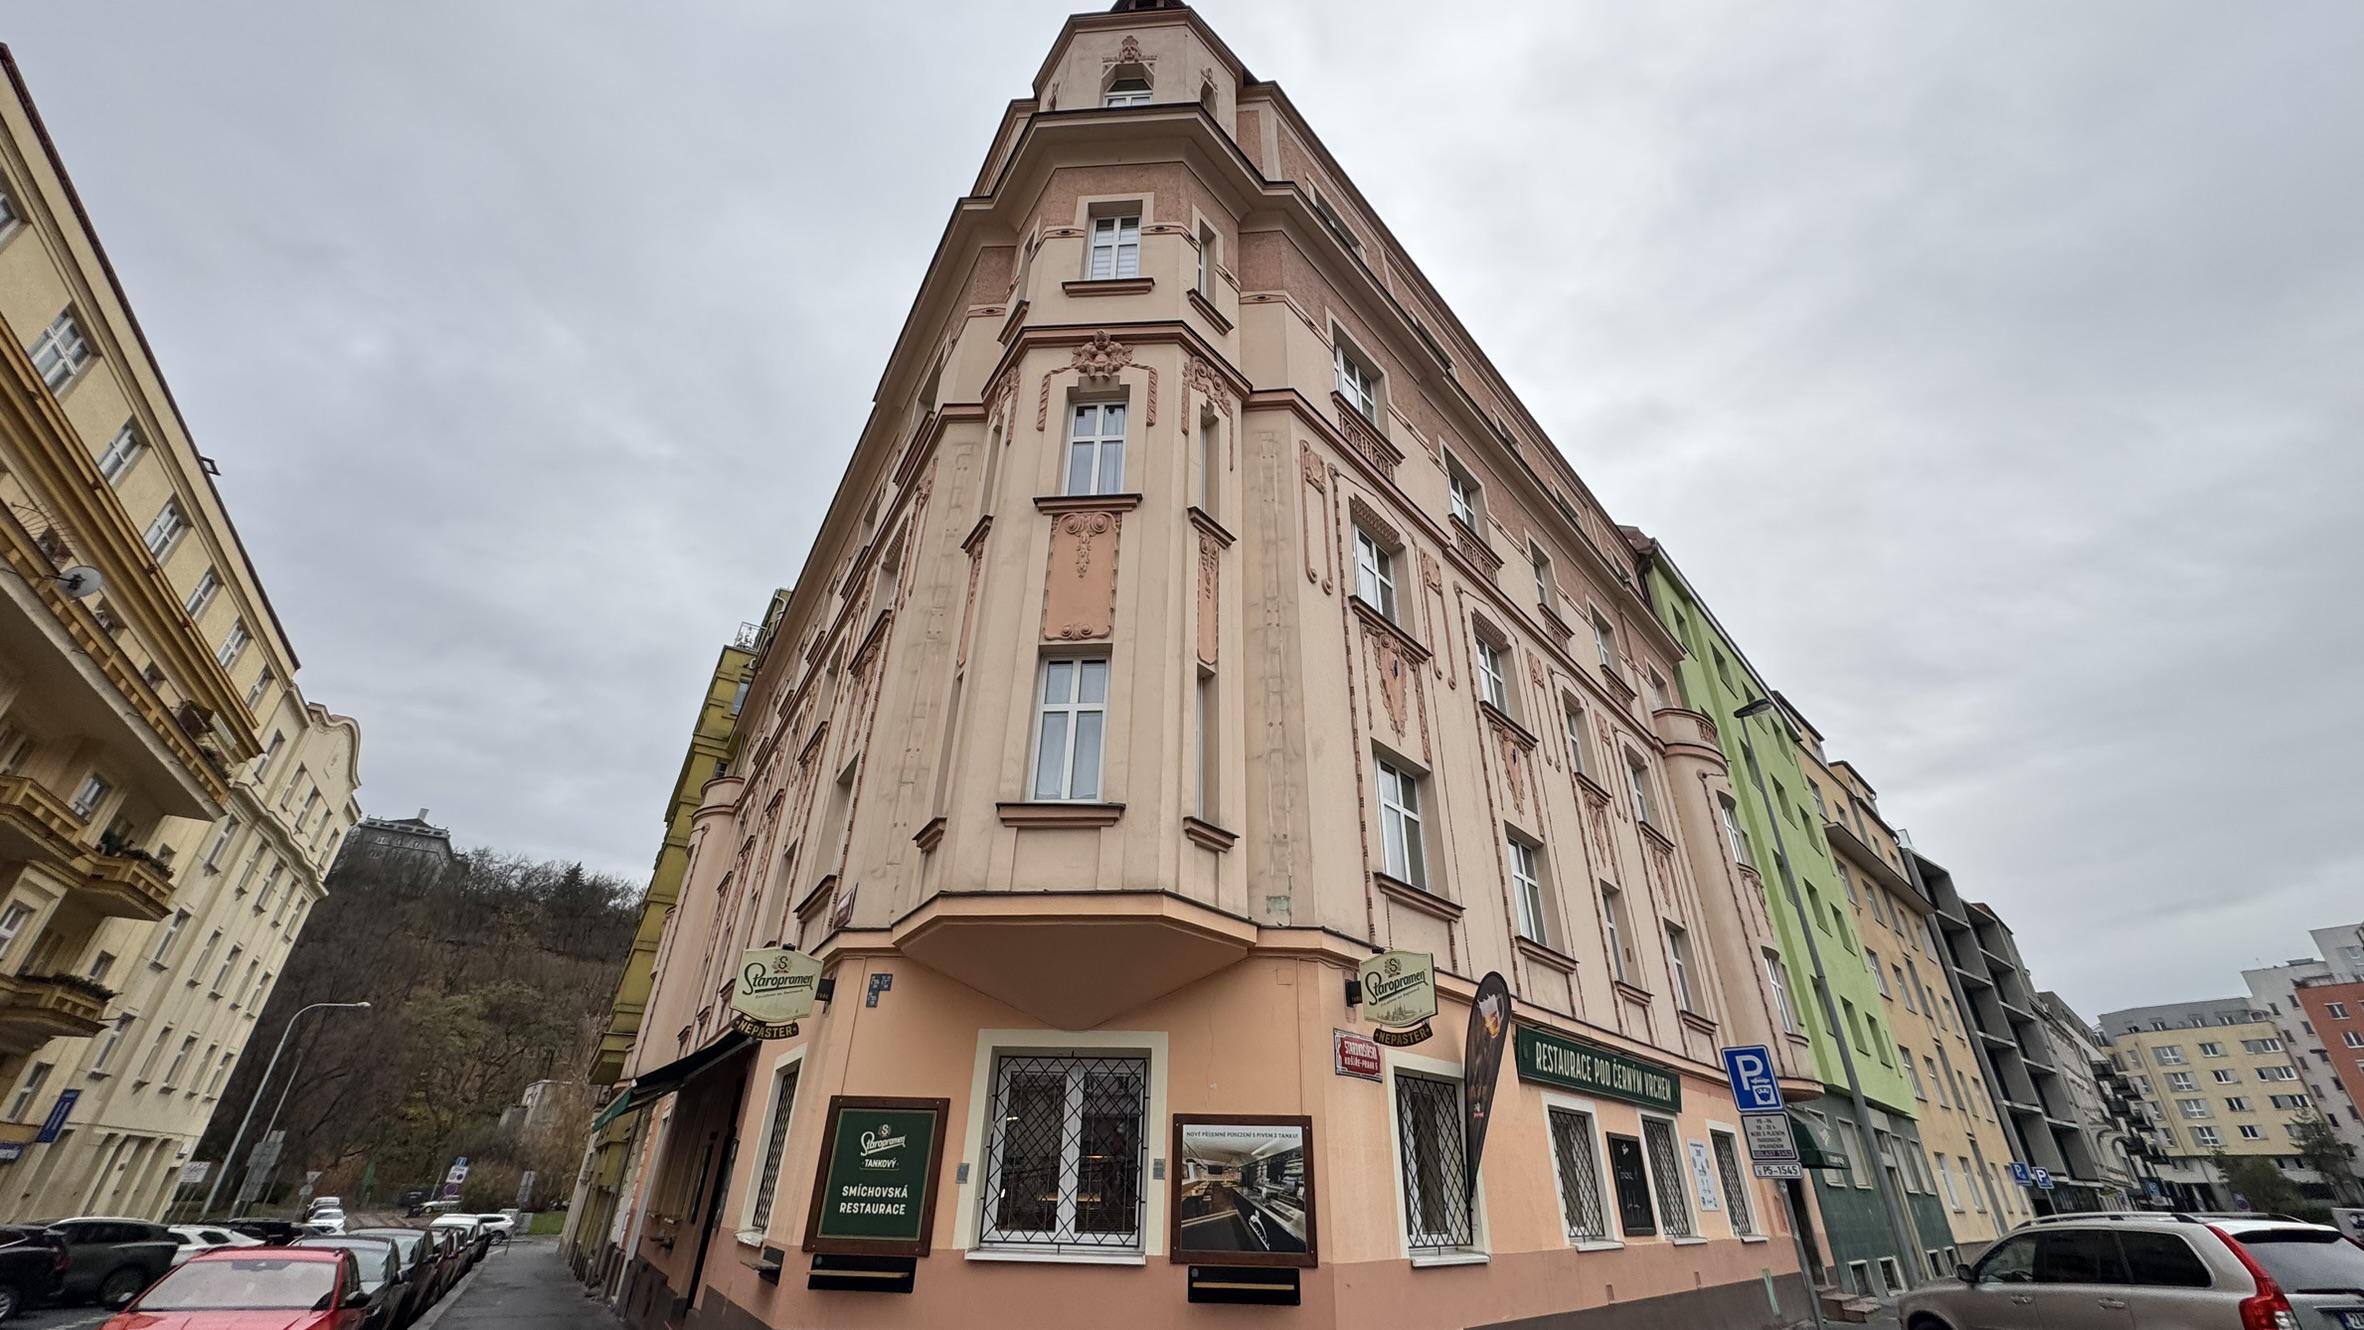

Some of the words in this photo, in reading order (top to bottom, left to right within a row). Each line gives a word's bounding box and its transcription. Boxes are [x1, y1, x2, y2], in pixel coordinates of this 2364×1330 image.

[742, 962, 814, 996] Staropramen
[1365, 970, 1429, 1006] Staropramen
[738, 1020, 793, 1039] NEPASTER
[1379, 1028, 1427, 1046] NEPASTER
[1535, 1041, 1592, 1081] RESTAURACE
[1594, 1057, 1611, 1087] POD
[1612, 1058, 1643, 1094] ČERNÝM
[1644, 1071, 1672, 1102] VRCHEM
[1735, 1055, 1764, 1091] P
[860, 1131, 907, 1156] Staropramen
[865, 1157, 897, 1168] TANKOVÝ
[2036, 1169, 2047, 1182] P
[842, 1183, 908, 1198] SMÍCHOVSKÁ
[839, 1203, 906, 1215] RESTAURACE
